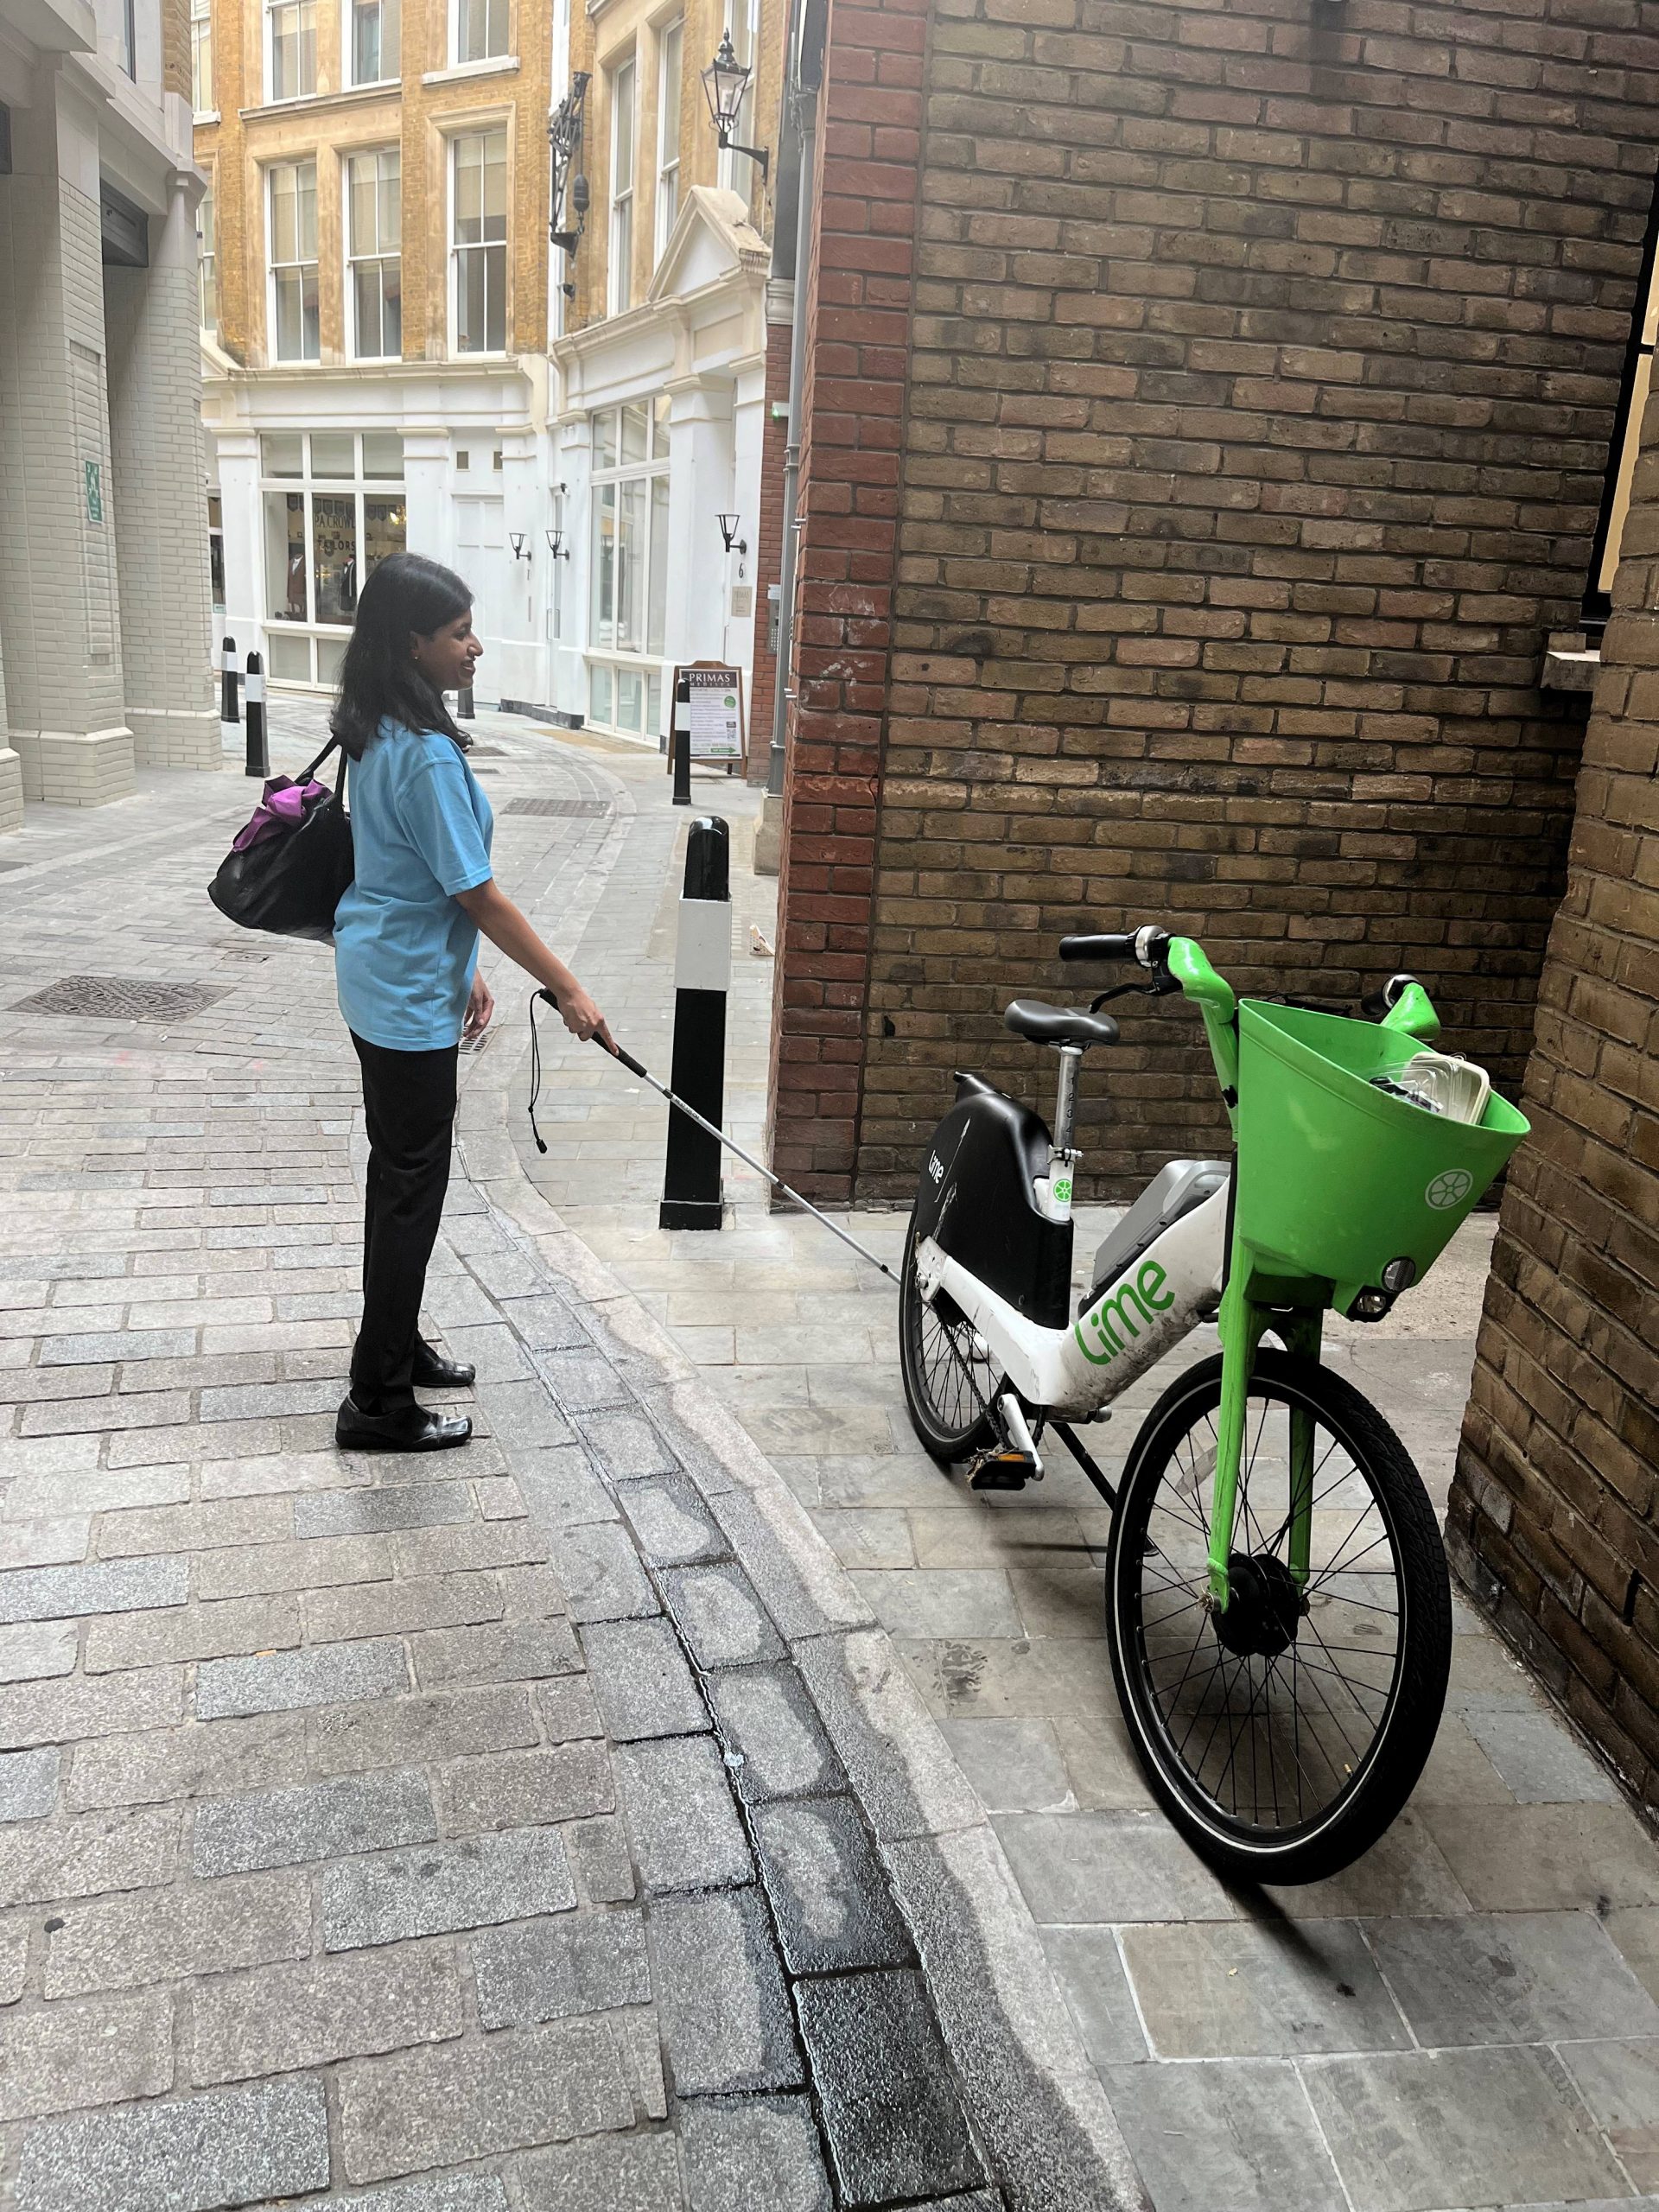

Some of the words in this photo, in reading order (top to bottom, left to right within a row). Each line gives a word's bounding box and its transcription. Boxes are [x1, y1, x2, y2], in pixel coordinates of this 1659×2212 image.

[317, 539, 356, 551] TLORS
[739, 563, 744, 579] 6
[690, 672, 731, 683] PRIMAS
[1068, 1092, 1075, 1102] 2
[1066, 1109, 1073, 1119] 3
